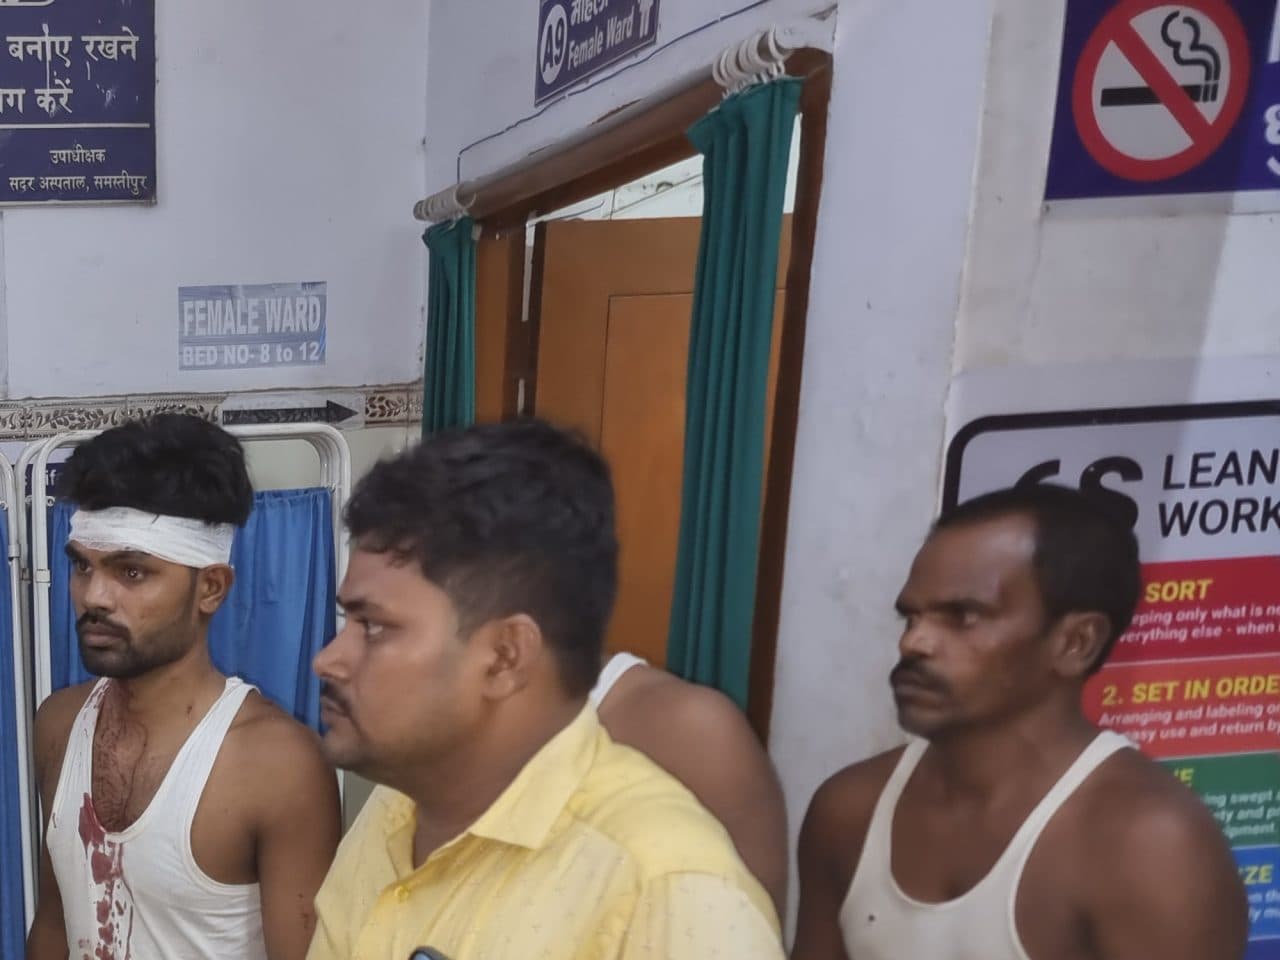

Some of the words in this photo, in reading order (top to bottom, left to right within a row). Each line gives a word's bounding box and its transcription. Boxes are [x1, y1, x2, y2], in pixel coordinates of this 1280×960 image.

[81, 26, 139, 61] रखने
[543, 16, 563, 72] A9
[568, 26, 603, 70] Female
[606, 6, 634, 48] Ward
[35, 78, 73, 115] करें
[9, 177, 35, 192] सदर
[94, 170, 147, 194] समस्तीपुर
[183, 298, 259, 336] FEMALE
[264, 295, 321, 333] WARD
[182, 345, 217, 365] BED
[260, 343, 270, 363] 8
[276, 344, 292, 362] to
[300, 341, 320, 361] 12
[1162, 448, 1280, 491] LEAN
[1144, 578, 1213, 603] SORT
[1176, 606, 1208, 624] only
[1211, 604, 1247, 619] what
[1250, 604, 1263, 617] is
[1119, 626, 1188, 645] verything
[1191, 625, 1222, 638] else
[1236, 621, 1275, 635] when
[1102, 686, 1124, 705] 2.
[1132, 681, 1179, 703] SET
[1184, 678, 1211, 700] IN
[1098, 710, 1172, 727] Arranging
[1175, 706, 1202, 720] and
[1206, 703, 1264, 718] labeling
[1160, 726, 1188, 739] use
[1190, 723, 1218, 736] and
[1220, 721, 1264, 734] return
